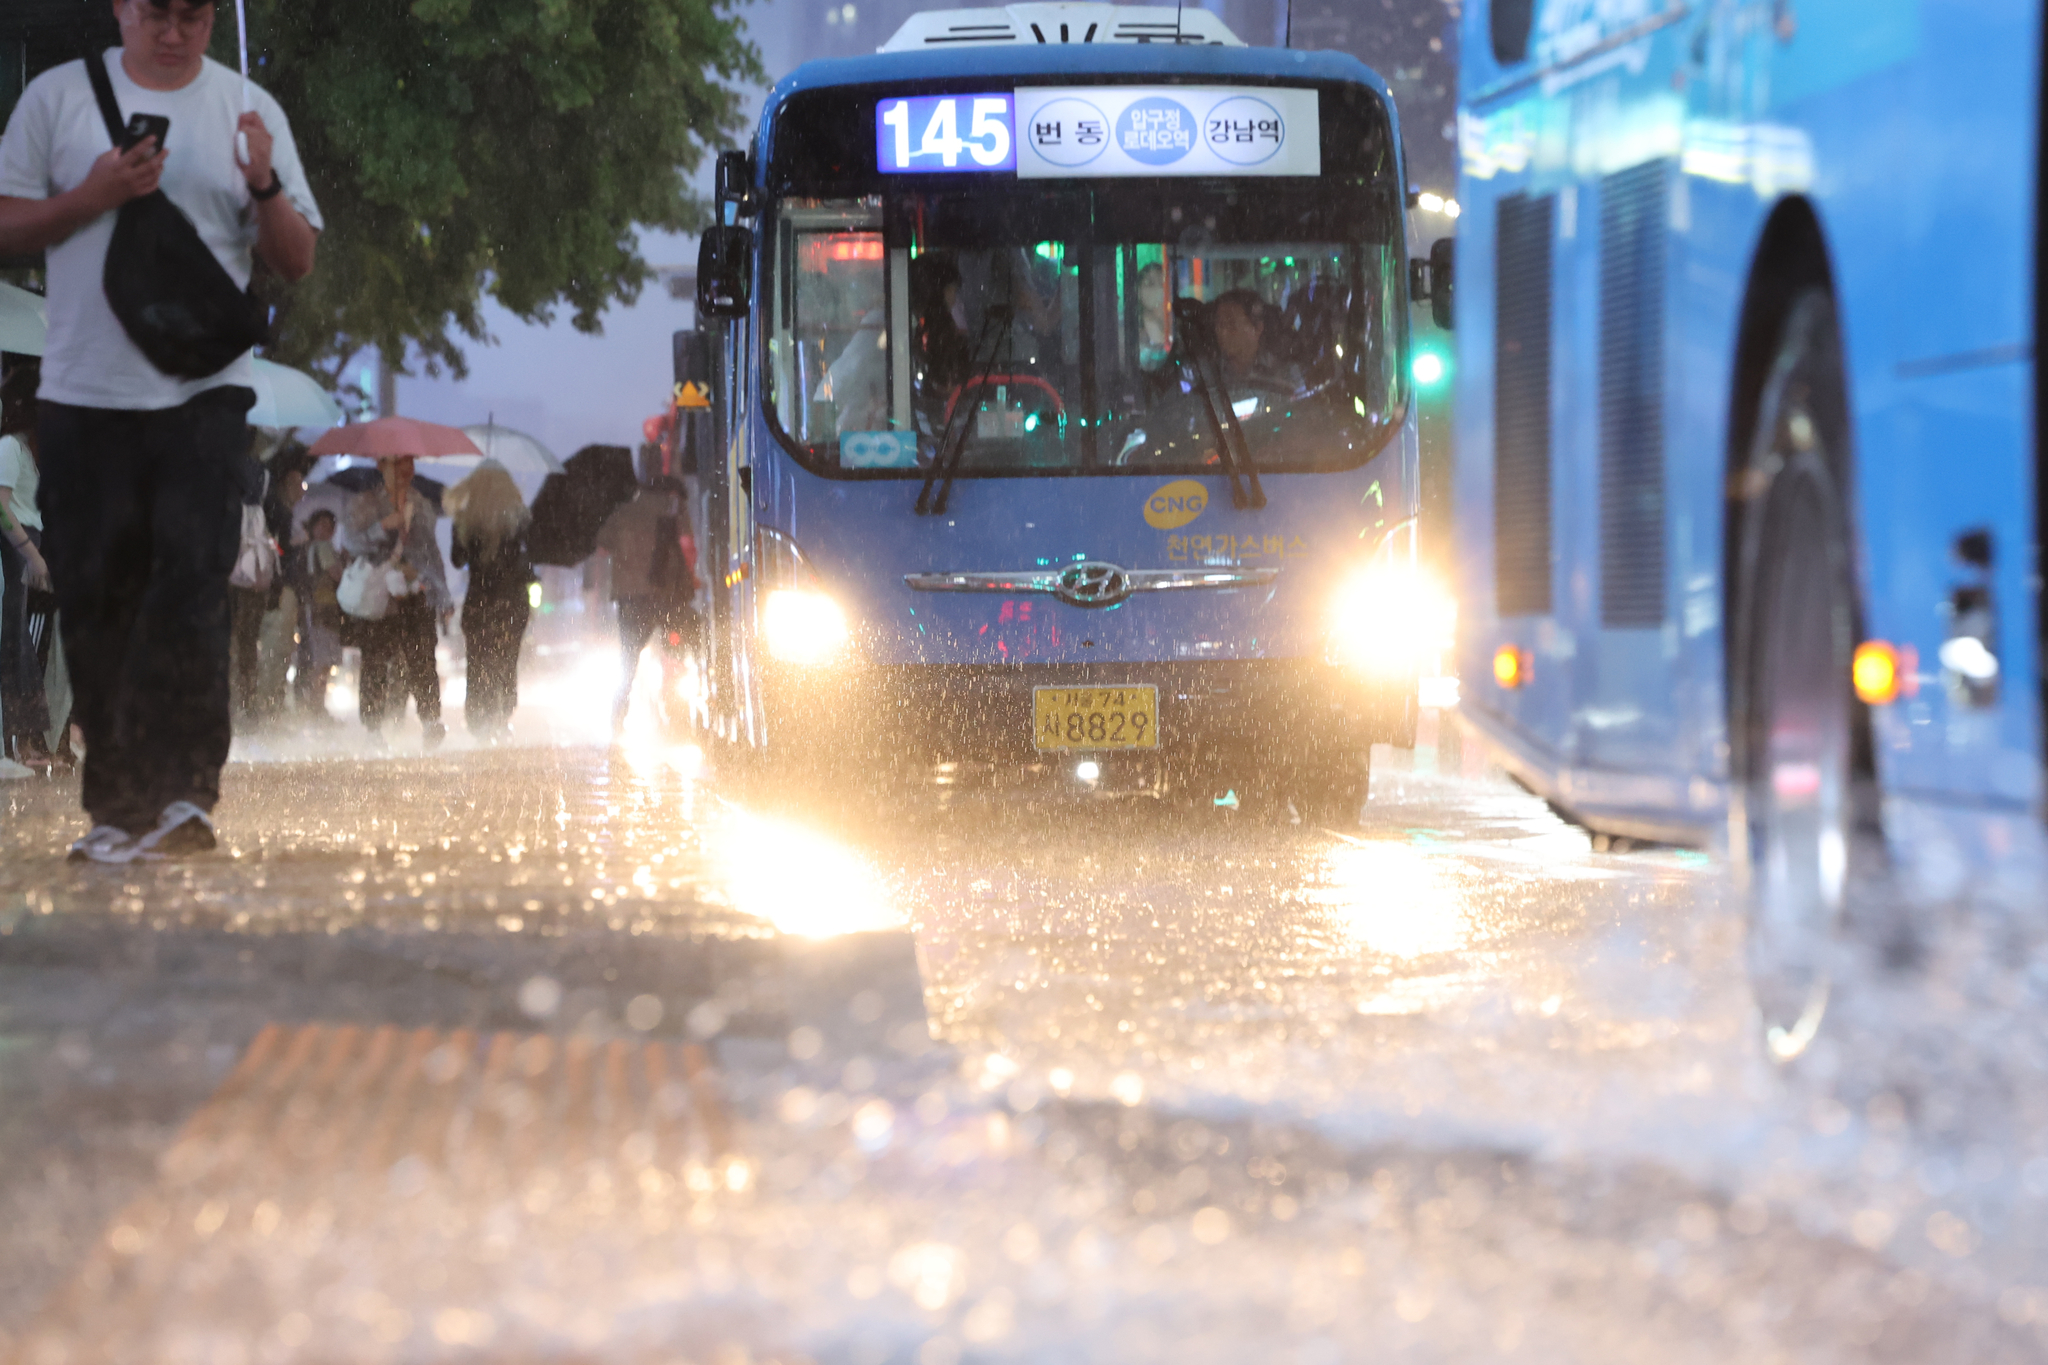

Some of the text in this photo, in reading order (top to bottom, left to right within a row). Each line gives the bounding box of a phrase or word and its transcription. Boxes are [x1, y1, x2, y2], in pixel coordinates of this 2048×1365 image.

[1131, 108, 1181, 131] 압구정
[1209, 118, 1280, 143] 강남역
[884, 97, 1010, 168] 145
[1123, 128, 1190, 151] 로데오역
[1150, 495, 1202, 513] CNG
